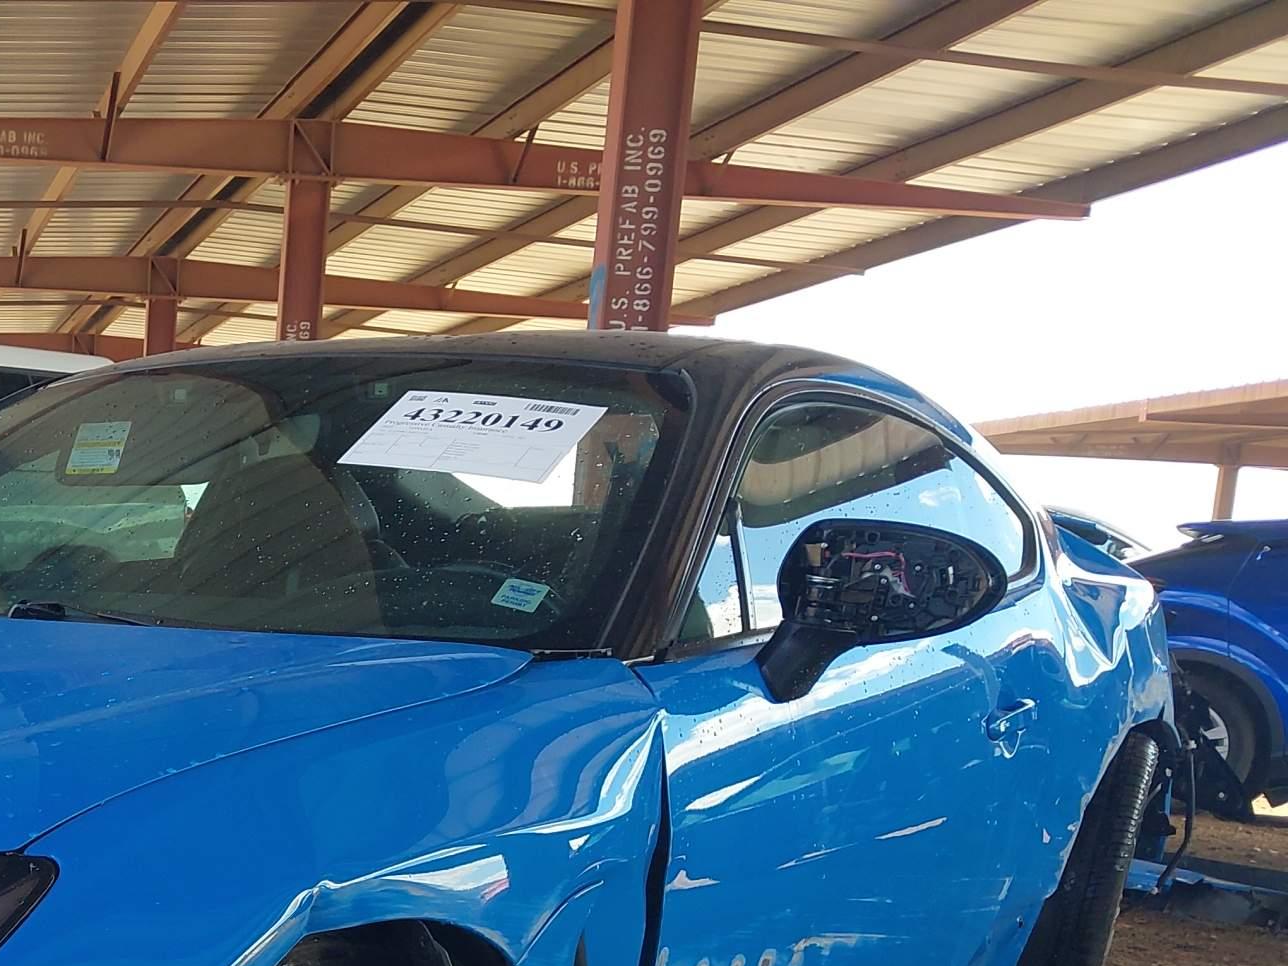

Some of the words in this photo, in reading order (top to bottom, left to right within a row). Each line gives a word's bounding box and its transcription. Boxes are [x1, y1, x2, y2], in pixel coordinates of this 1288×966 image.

[623, 127, 646, 172] INC.
[615, 184, 640, 276] PREFAB
[630, 128, 668, 331] 1-866-799-0969
[403, 406, 564, 433] 43220149
